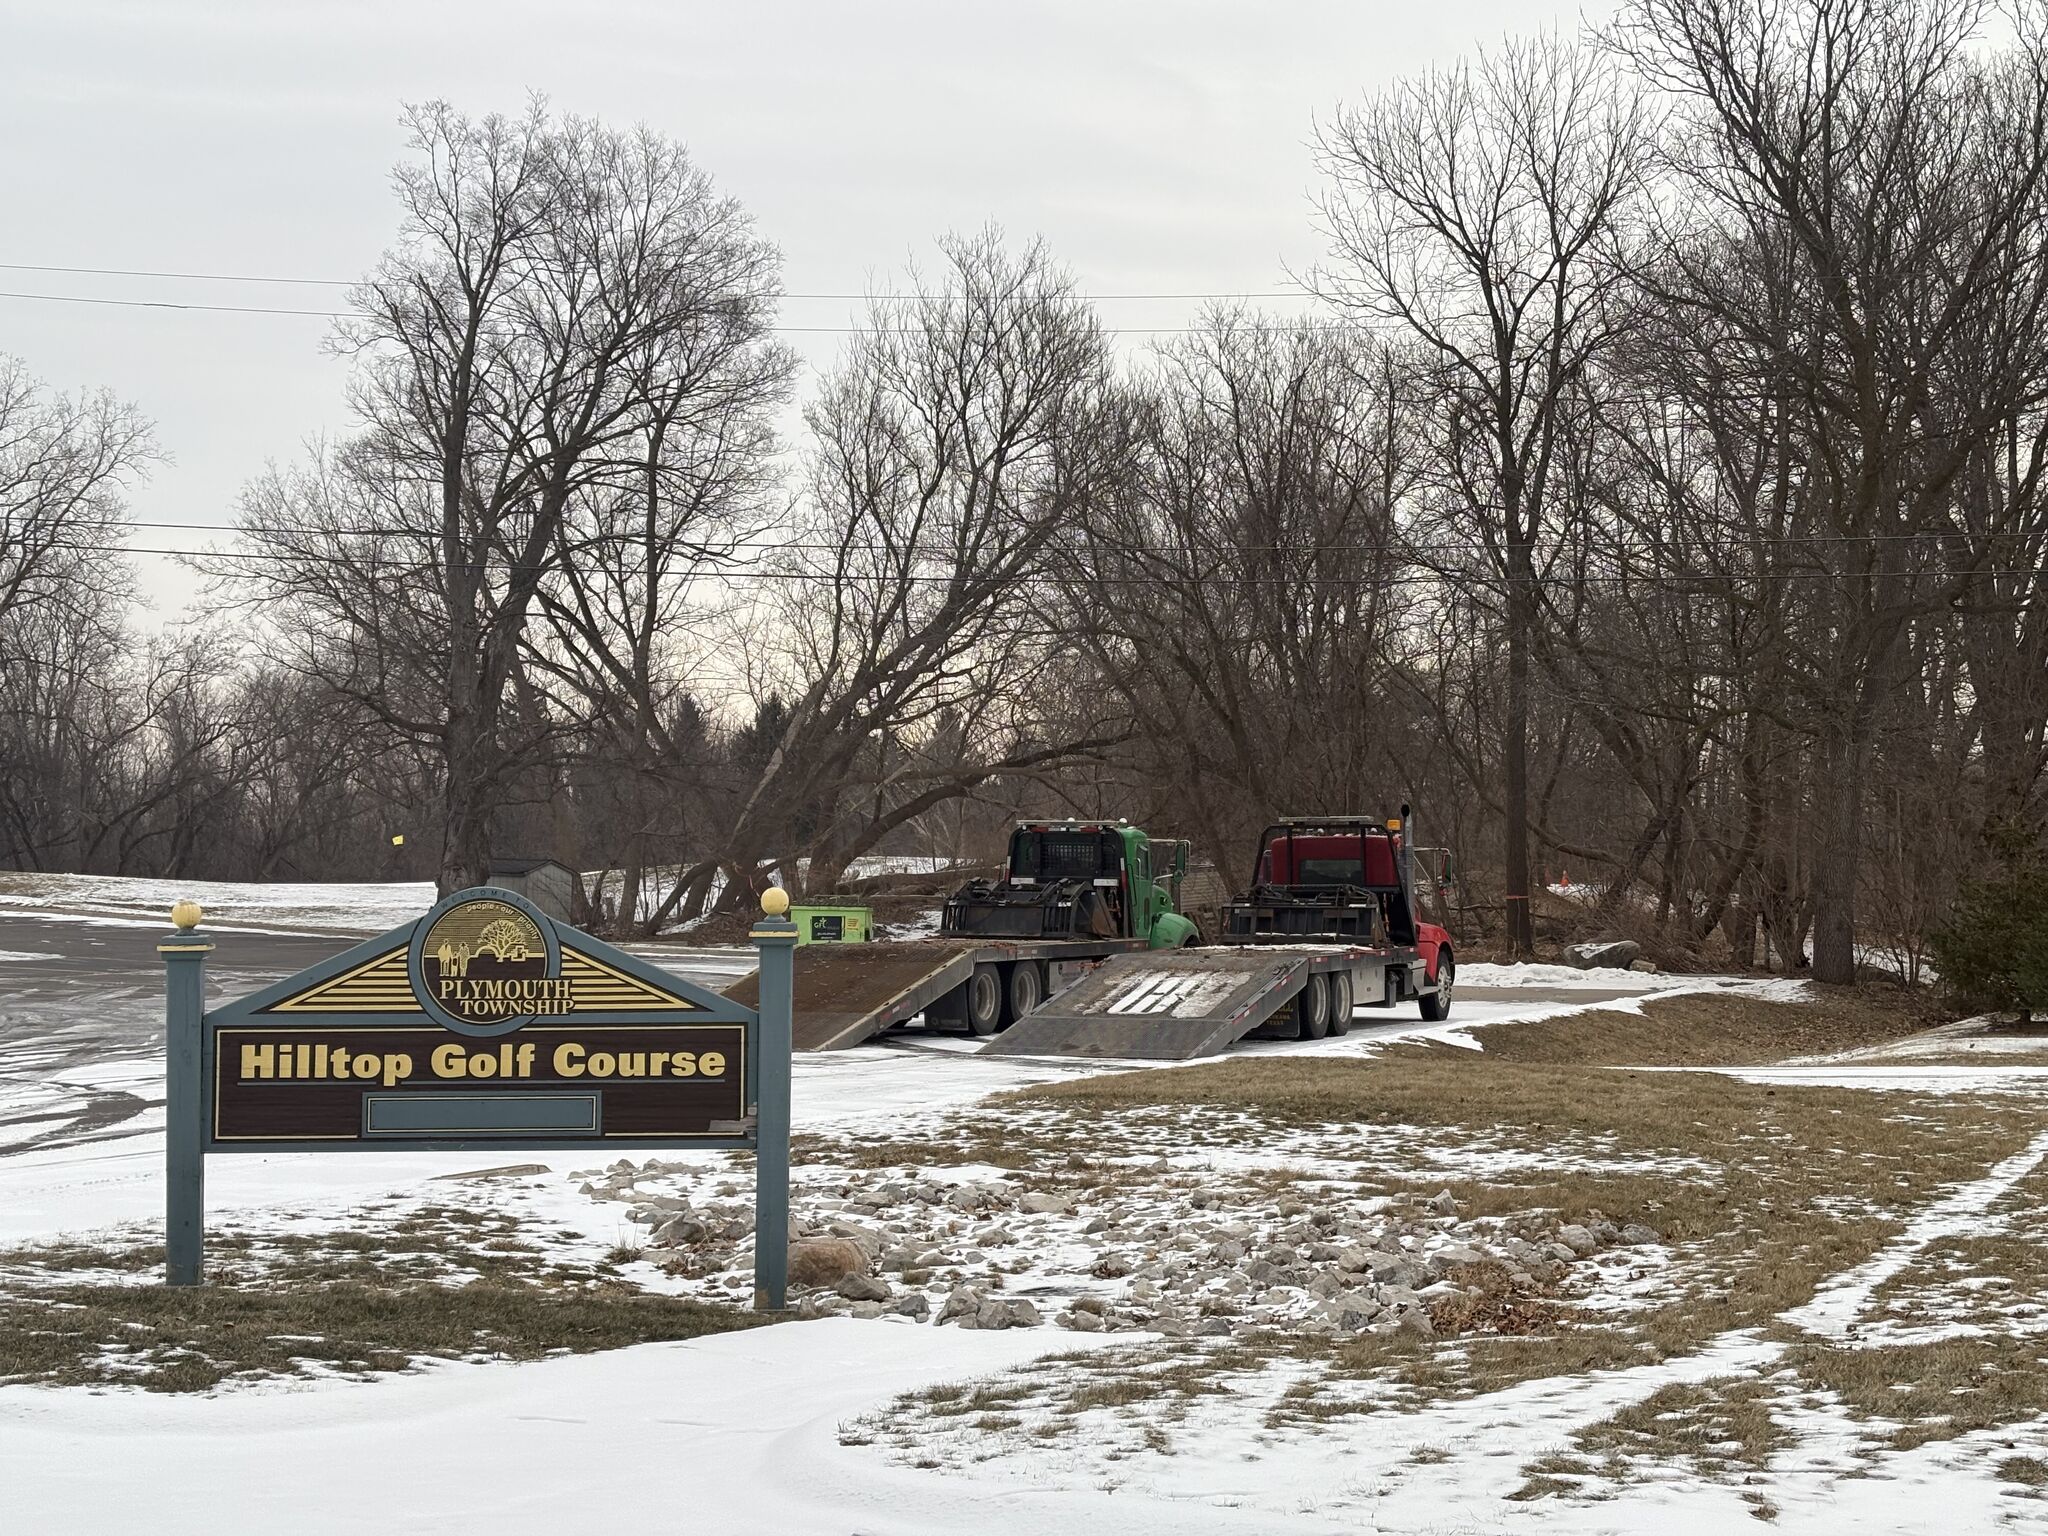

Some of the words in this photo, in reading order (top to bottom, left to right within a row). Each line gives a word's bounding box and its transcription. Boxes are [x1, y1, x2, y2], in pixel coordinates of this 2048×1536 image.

[442, 889, 507, 909] WELCOME
[516, 897, 530, 909] TO
[466, 903, 494, 912] people
[500, 906, 514, 915] our
[517, 916, 539, 939] priority
[439, 979, 571, 1000] PLYMOUTH
[460, 999, 574, 1015] TOWNSHIP
[239, 1043, 413, 1086] Hilltop
[430, 1043, 536, 1079] Golf
[552, 1042, 726, 1079] Course
